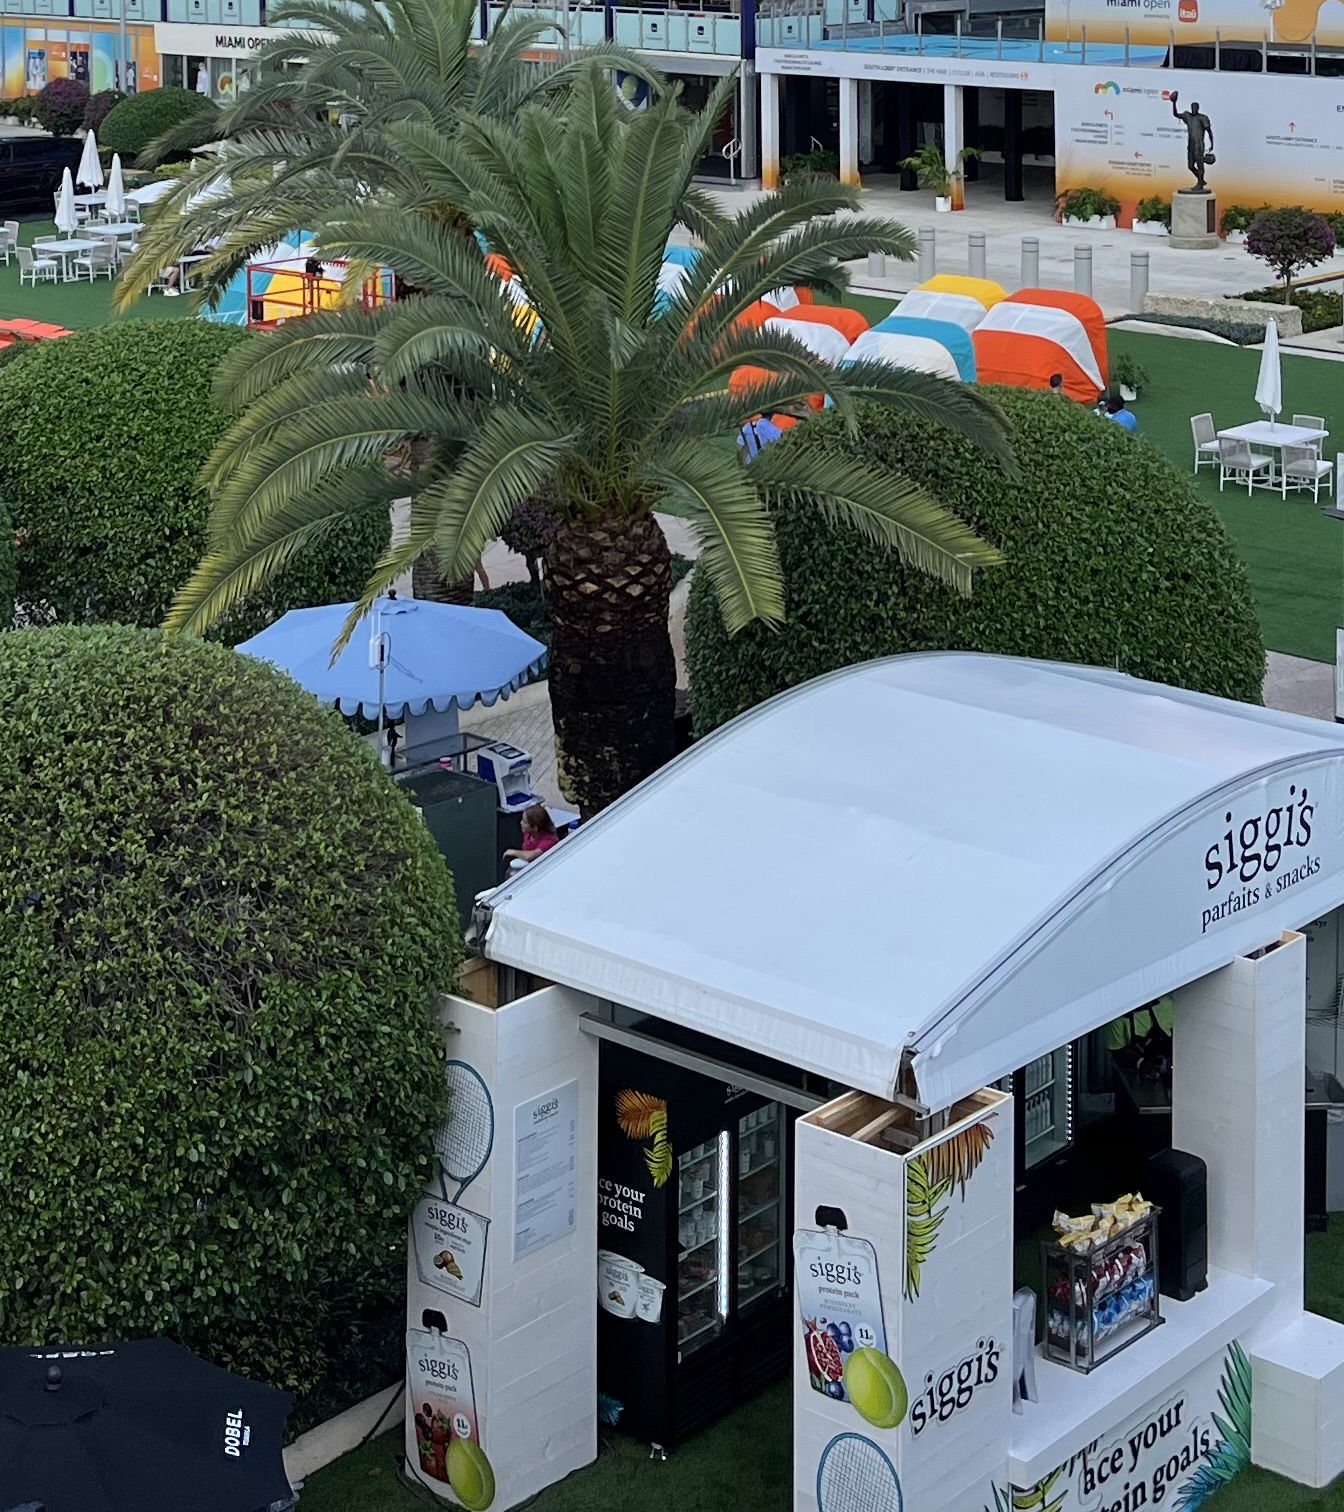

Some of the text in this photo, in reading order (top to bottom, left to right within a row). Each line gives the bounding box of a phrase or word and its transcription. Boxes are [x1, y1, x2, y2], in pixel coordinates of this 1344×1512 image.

[1143, 0, 1171, 11] open
[216, 35, 245, 49] MIAMI
[1205, 784, 1315, 890] siggi's
[1201, 886, 1260, 934] parfaits
[1264, 882, 1273, 900] &
[1276, 854, 1321, 894] snacks
[614, 1185, 646, 1205] your
[602, 1210, 635, 1232] goals
[809, 1255, 863, 1285] siggi's
[818, 1285, 843, 1297] protein
[911, 1339, 1000, 1435] siggi's
[225, 1409, 244, 1458] DOBEL
[1128, 1398, 1184, 1473] your
[1152, 1425, 1210, 1505] goals
